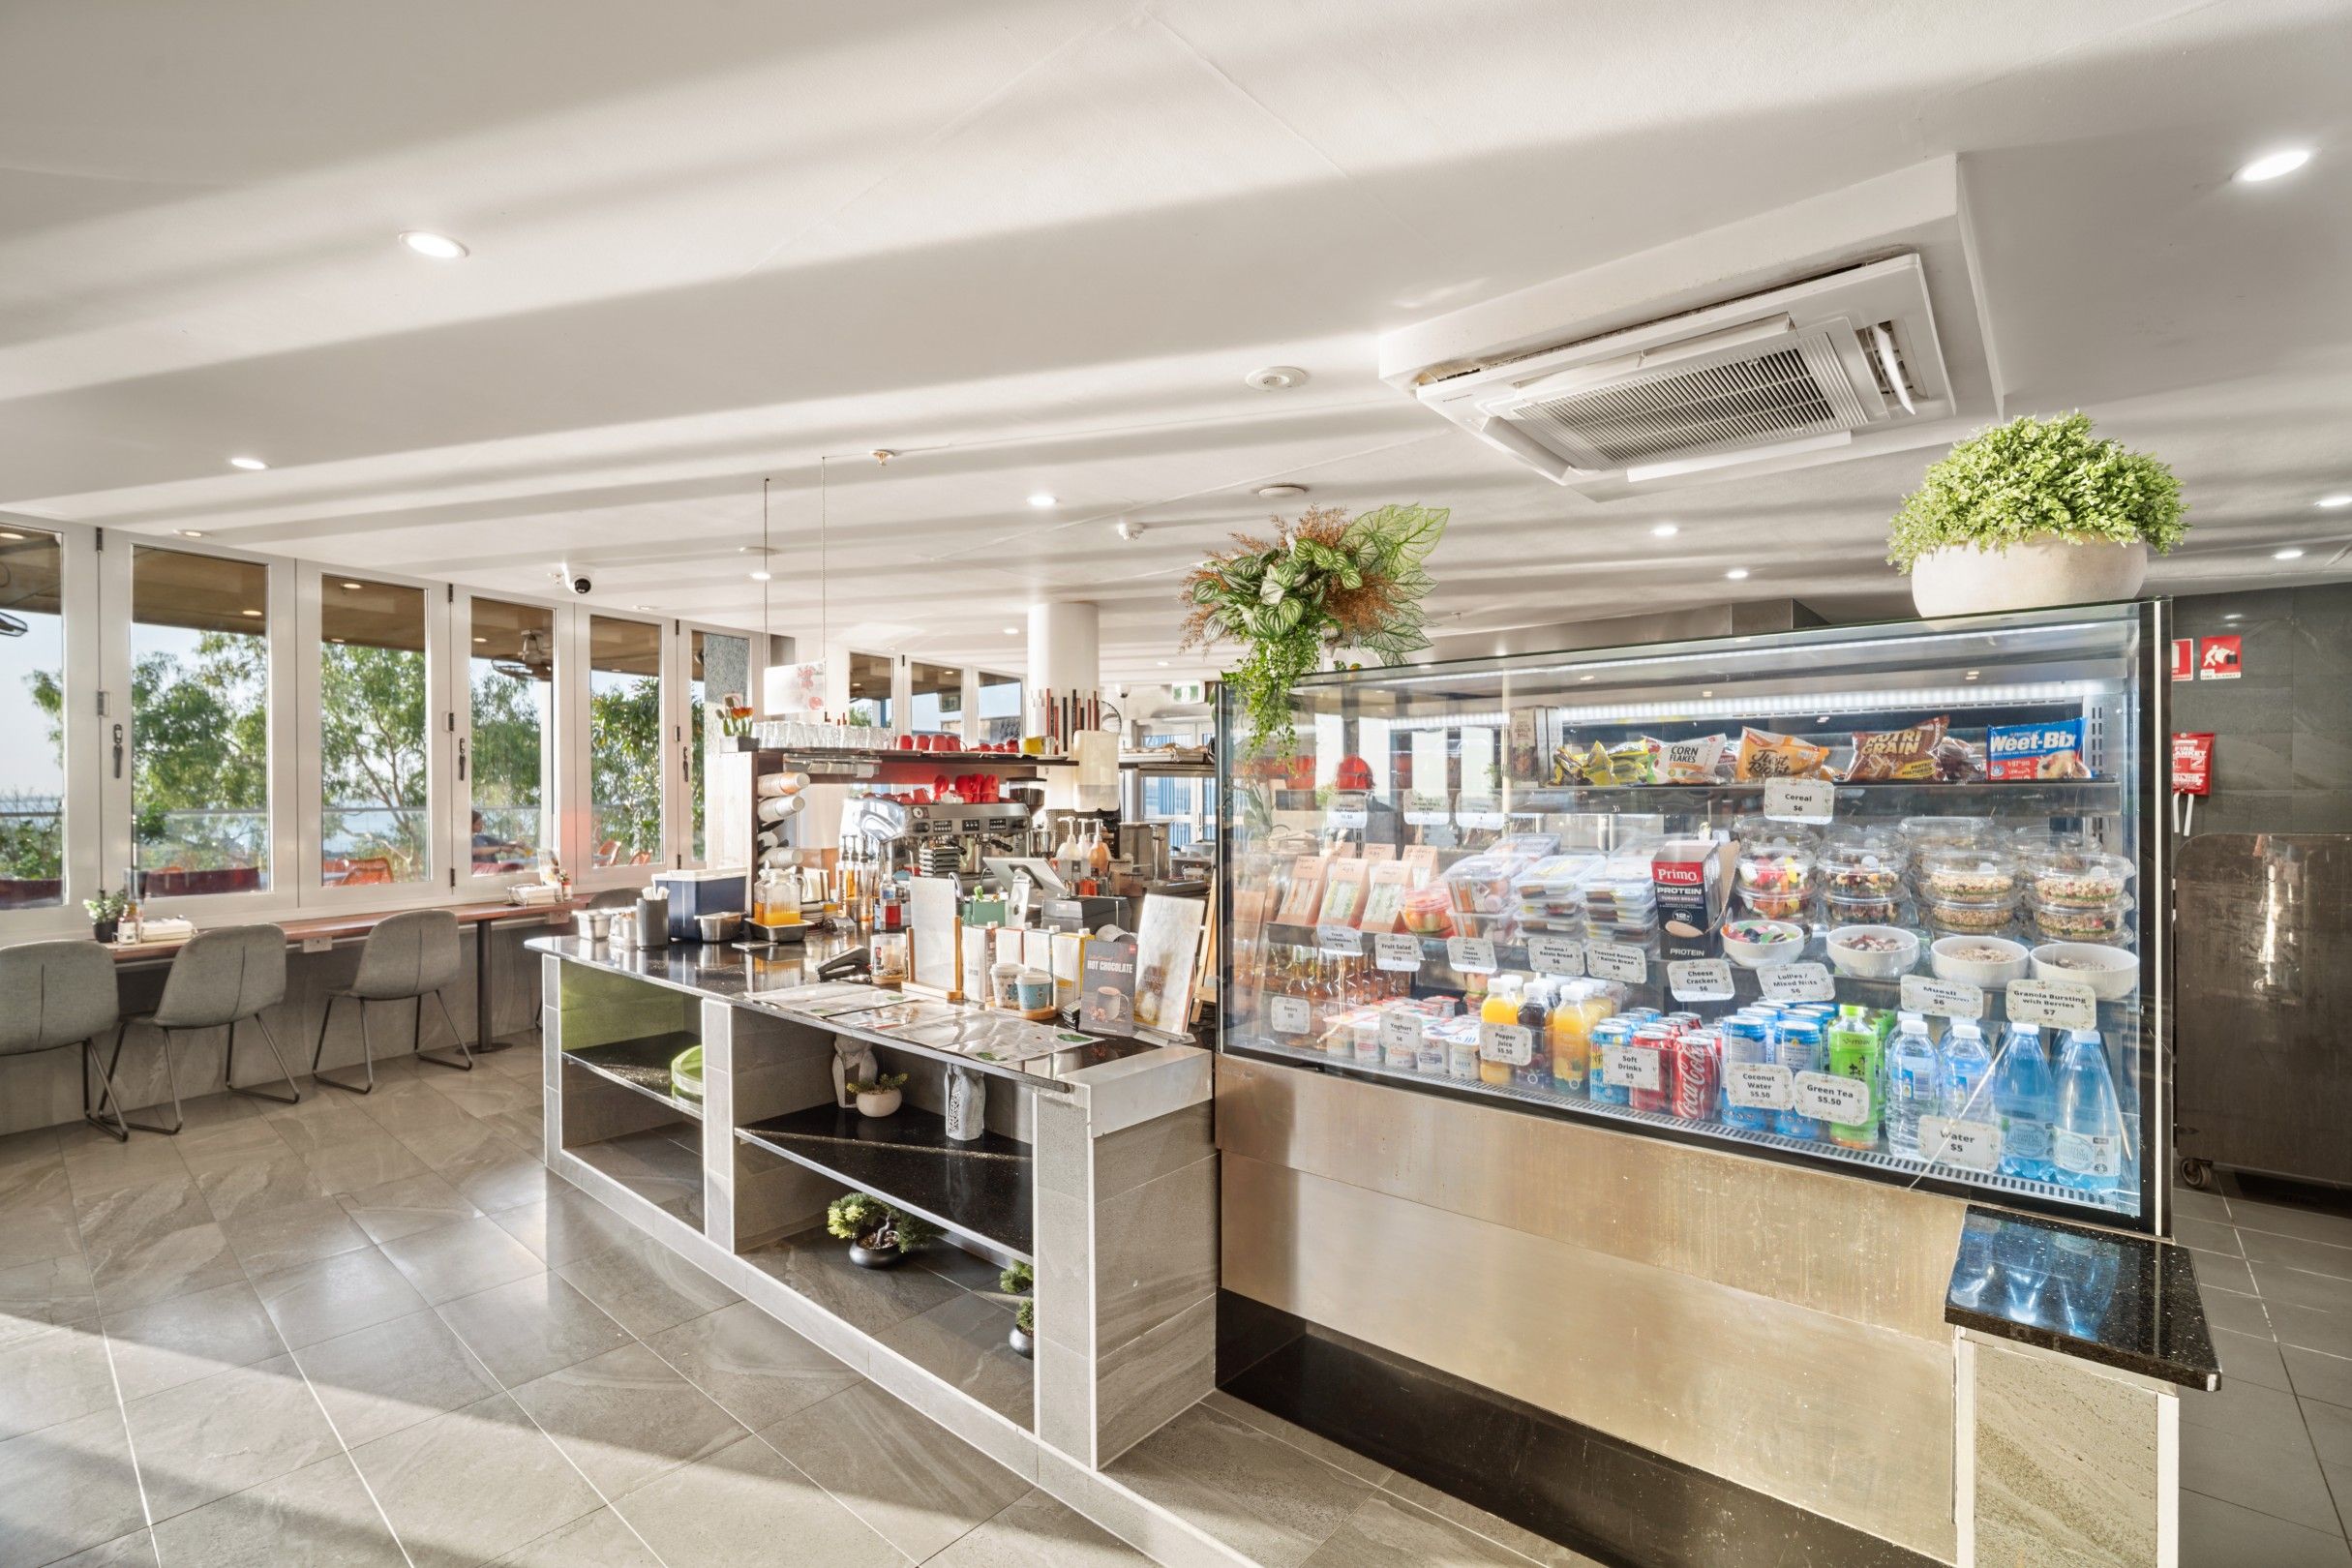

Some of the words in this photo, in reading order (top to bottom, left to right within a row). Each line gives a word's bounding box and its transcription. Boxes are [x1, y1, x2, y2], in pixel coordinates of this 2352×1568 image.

[1866, 731, 1922, 745] NUTRI
[1990, 730, 2077, 753] Weet-Bix
[1671, 746, 1699, 756] CORN
[1861, 741, 1920, 757] GRAIN
[1670, 754, 1696, 764] FLAKES
[1658, 869, 1698, 881] Primo
[1656, 887, 1703, 895] PROTEIN
[1670, 948, 1705, 956] PROTEIN
[1087, 960, 1100, 971] HOT
[1100, 961, 1133, 974] CHOCOLATE
[1923, 986, 1956, 996] Muesli
[2013, 990, 2047, 999] Granola
[2049, 994, 2087, 1004] Bursting
[1390, 1022, 1412, 1032] Yoghurt
[1494, 1032, 1517, 1041] Popper
[1622, 1055, 1638, 1064] Soft
[1617, 1063, 1643, 1072] Drinks
[1742, 1072, 1776, 1082] Coconut
[1807, 1084, 1835, 1096] Green
[1838, 1089, 1854, 1099] Tea
[1817, 1096, 1842, 1106] $5.50
[1940, 1130, 1975, 1144] Water
[1950, 1143, 1964, 1153] $5
